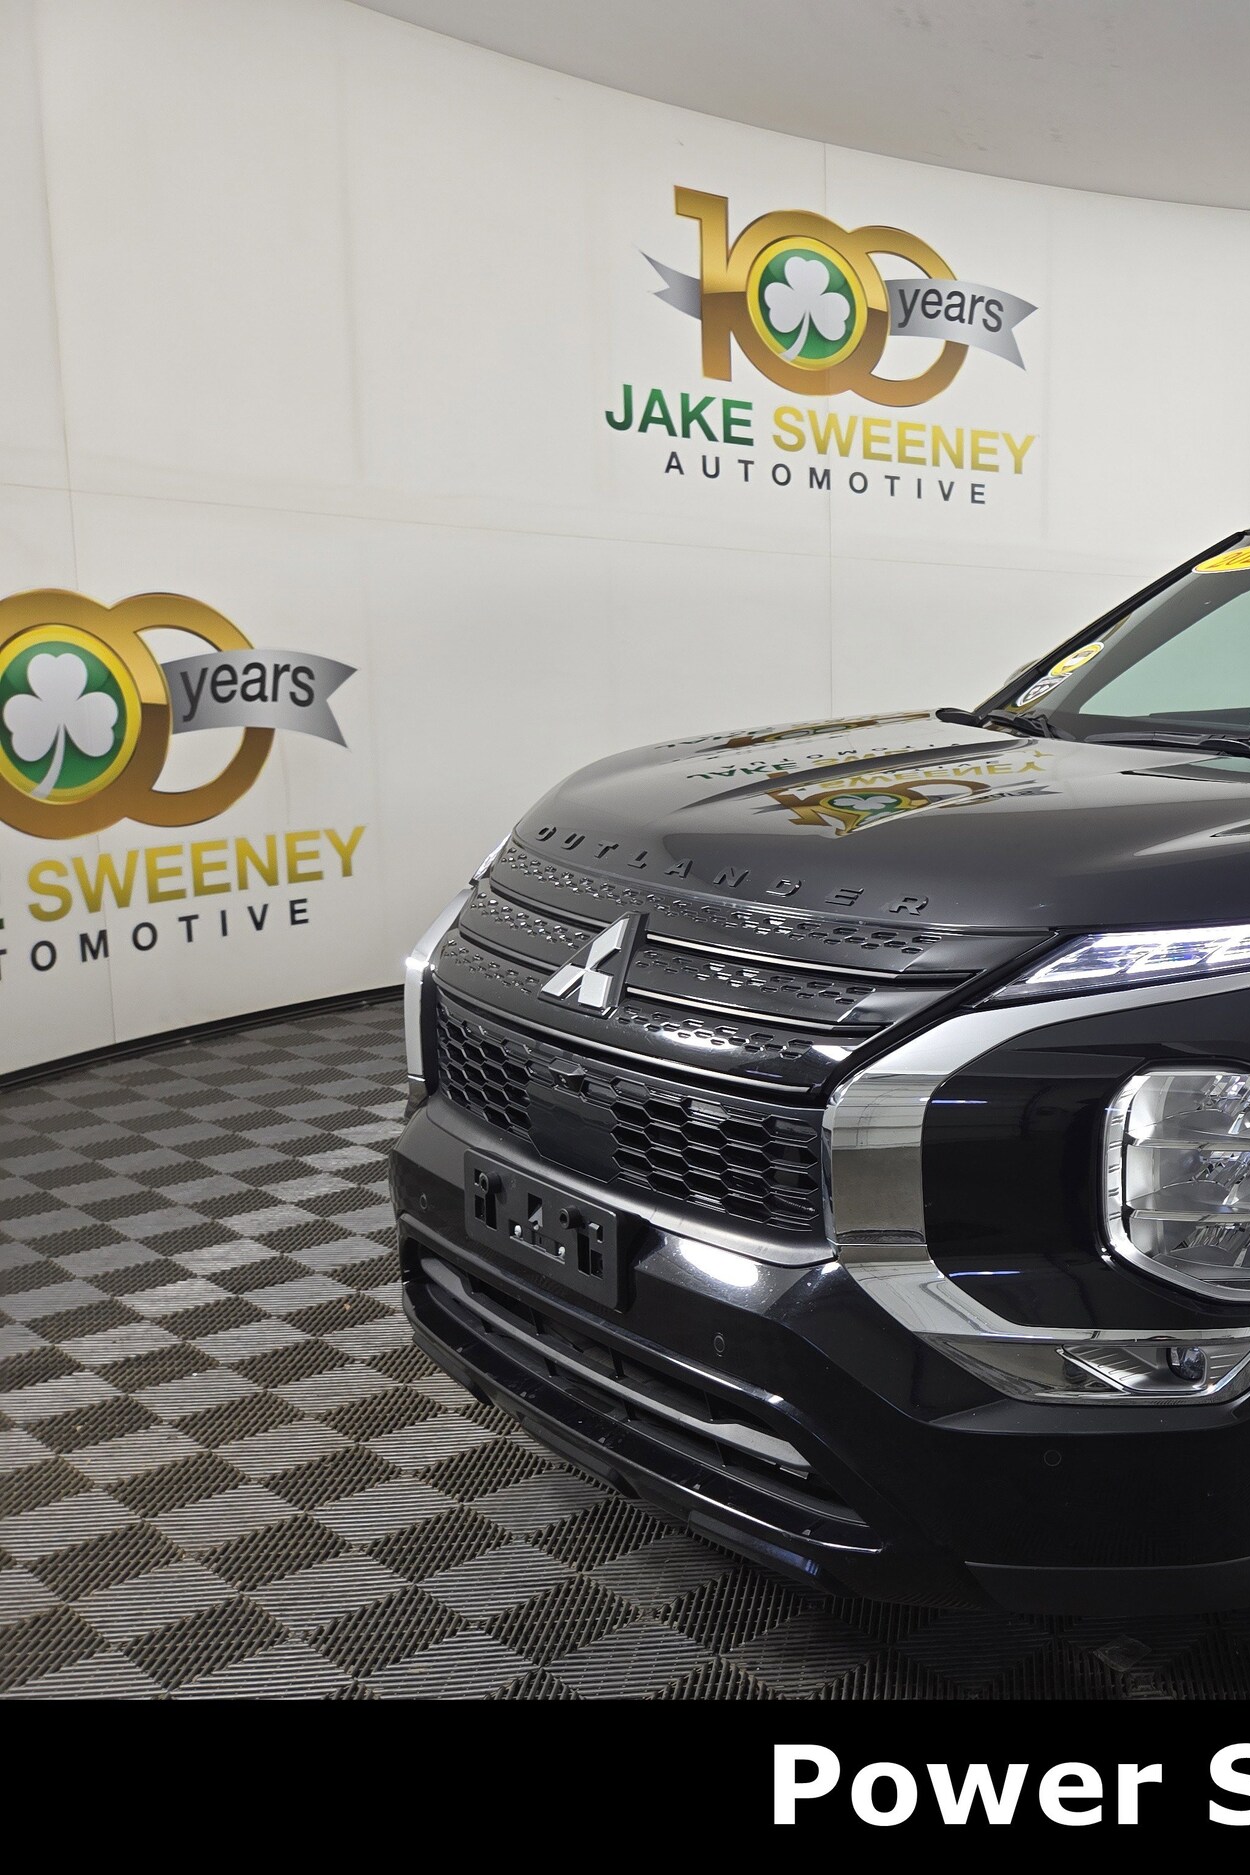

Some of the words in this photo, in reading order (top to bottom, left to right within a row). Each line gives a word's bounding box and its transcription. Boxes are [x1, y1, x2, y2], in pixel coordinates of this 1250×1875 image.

[673, 185, 971, 407] 100
[898, 286, 1005, 333] years
[605, 384, 754, 446] JAKE
[772, 406, 1035, 475] SWEENEY
[665, 451, 986, 504] AUTOMOTIVE
[180, 662, 316, 722] years
[27, 826, 366, 922] SWEENEY
[536, 825, 929, 916] OUTLANDER
[0, 898, 309, 981] OMOTIVE
